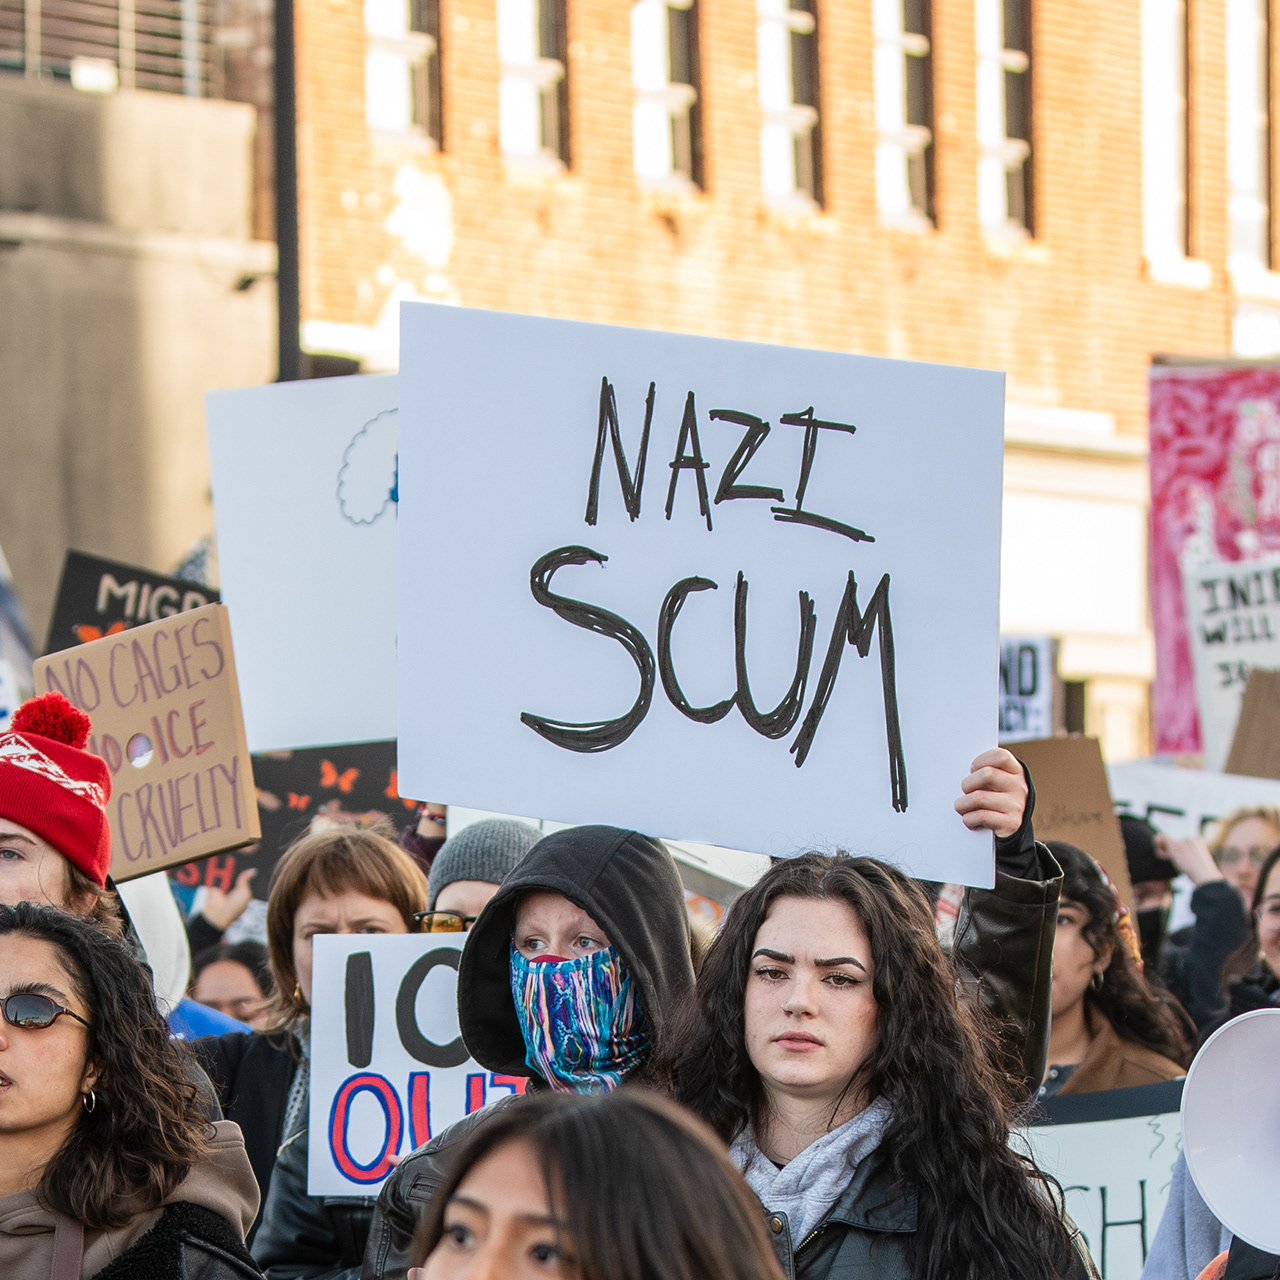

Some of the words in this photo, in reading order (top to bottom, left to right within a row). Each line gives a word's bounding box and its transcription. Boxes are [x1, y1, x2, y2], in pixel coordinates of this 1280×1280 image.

[584, 375, 875, 542] NAZI
[45, 657, 102, 713] NO
[108, 617, 226, 710] CAGES
[520, 543, 907, 813] SCUM
[150, 698, 217, 767] ICE
[119, 754, 244, 863] CRUELTY
